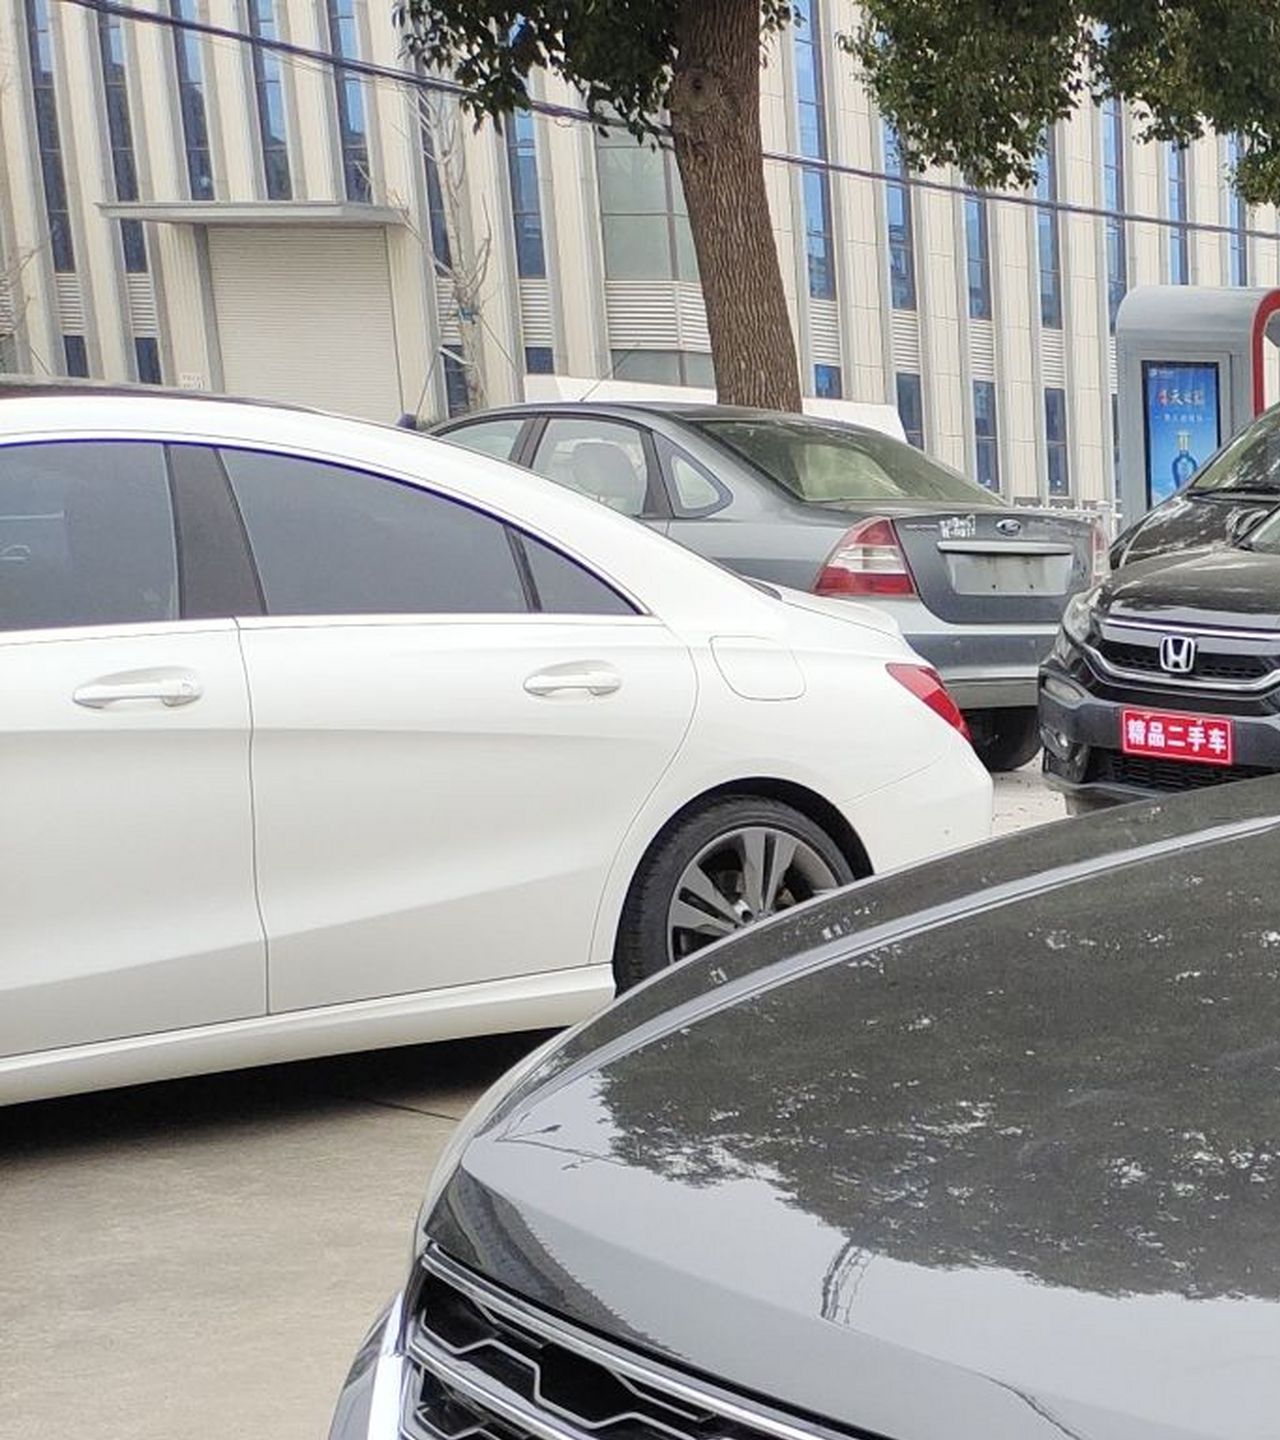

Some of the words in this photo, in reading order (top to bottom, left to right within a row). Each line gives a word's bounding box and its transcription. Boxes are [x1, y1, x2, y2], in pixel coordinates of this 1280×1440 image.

[1127, 719, 1227, 754] 精品二手车
